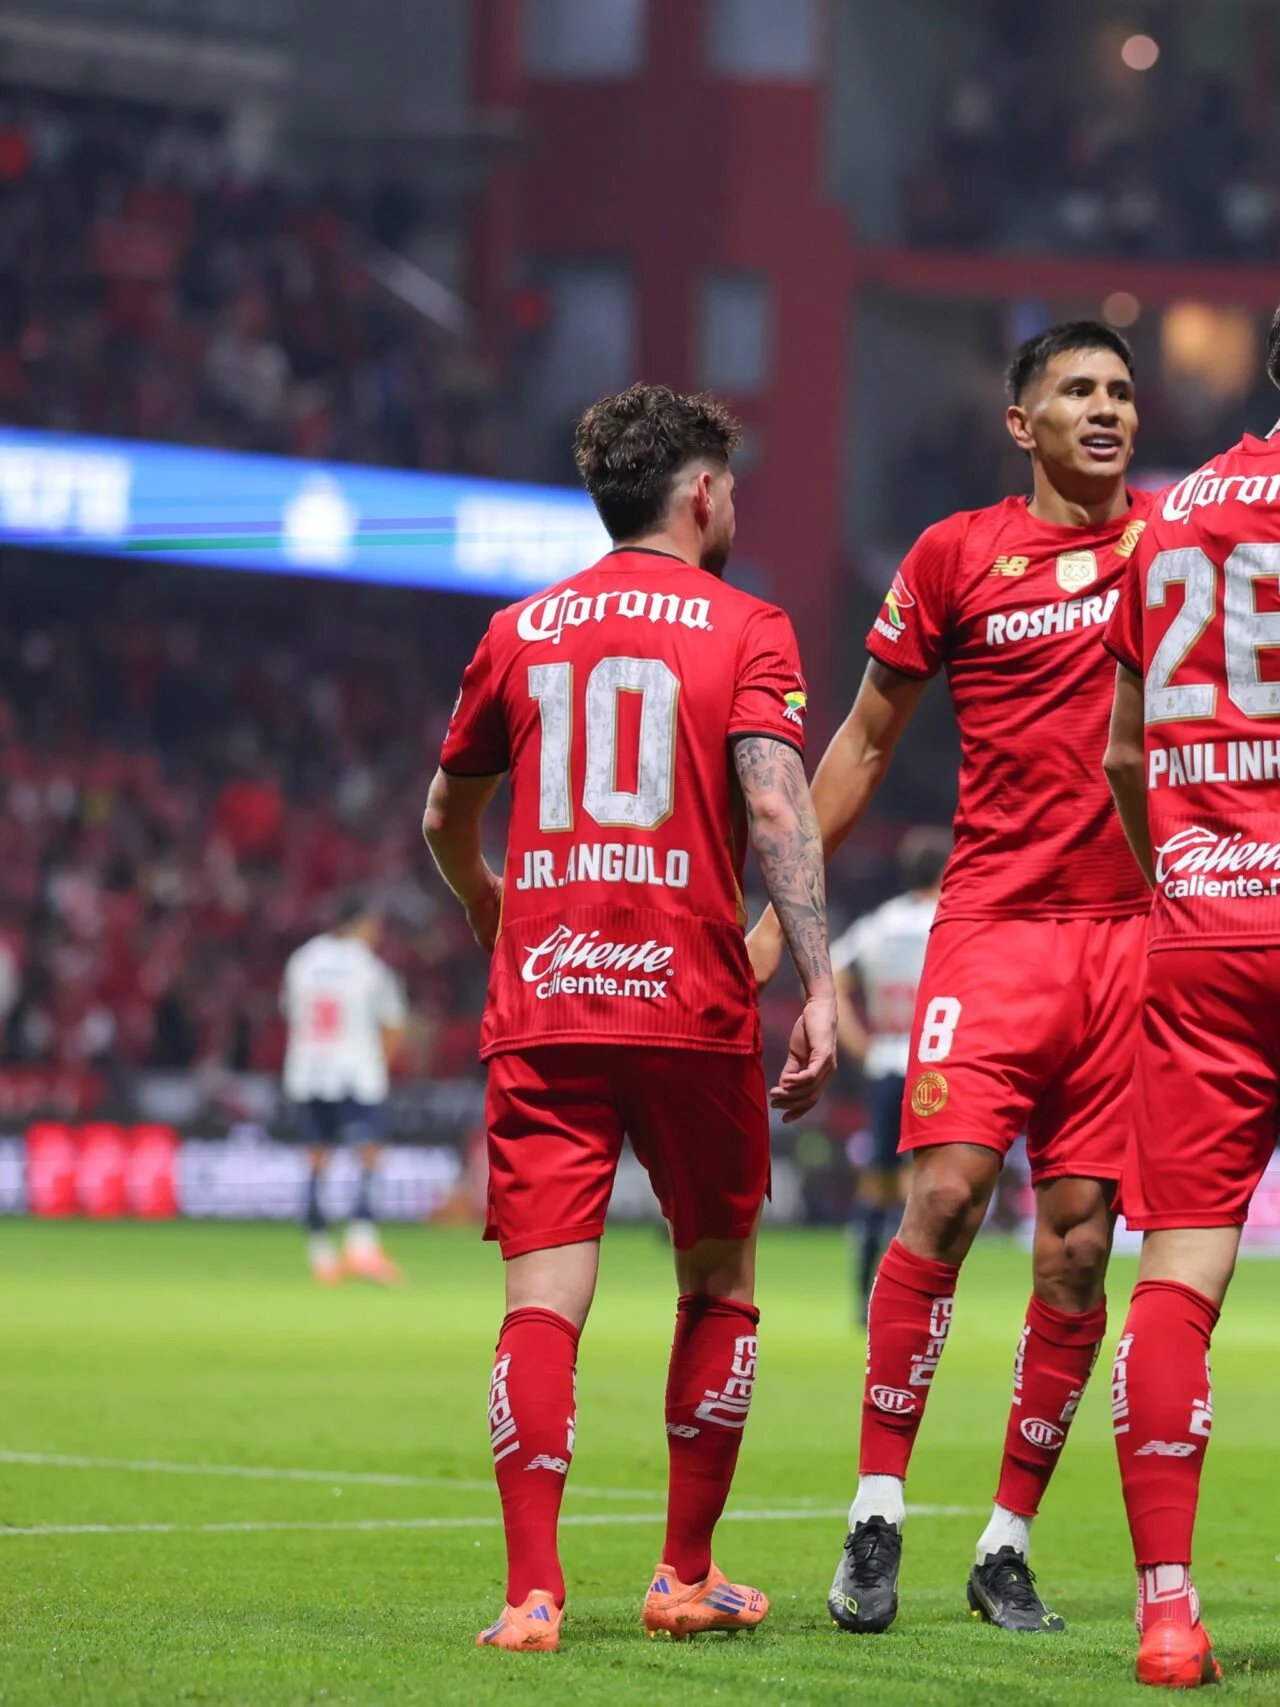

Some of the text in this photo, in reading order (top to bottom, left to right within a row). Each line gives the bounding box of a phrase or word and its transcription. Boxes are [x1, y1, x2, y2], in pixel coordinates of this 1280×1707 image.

[517, 587, 712, 644] Corona
[527, 656, 681, 833] 10
[521, 924, 674, 984] Caliente
[536, 972, 668, 1001] caliente.mx
[917, 996, 962, 1063] 8
